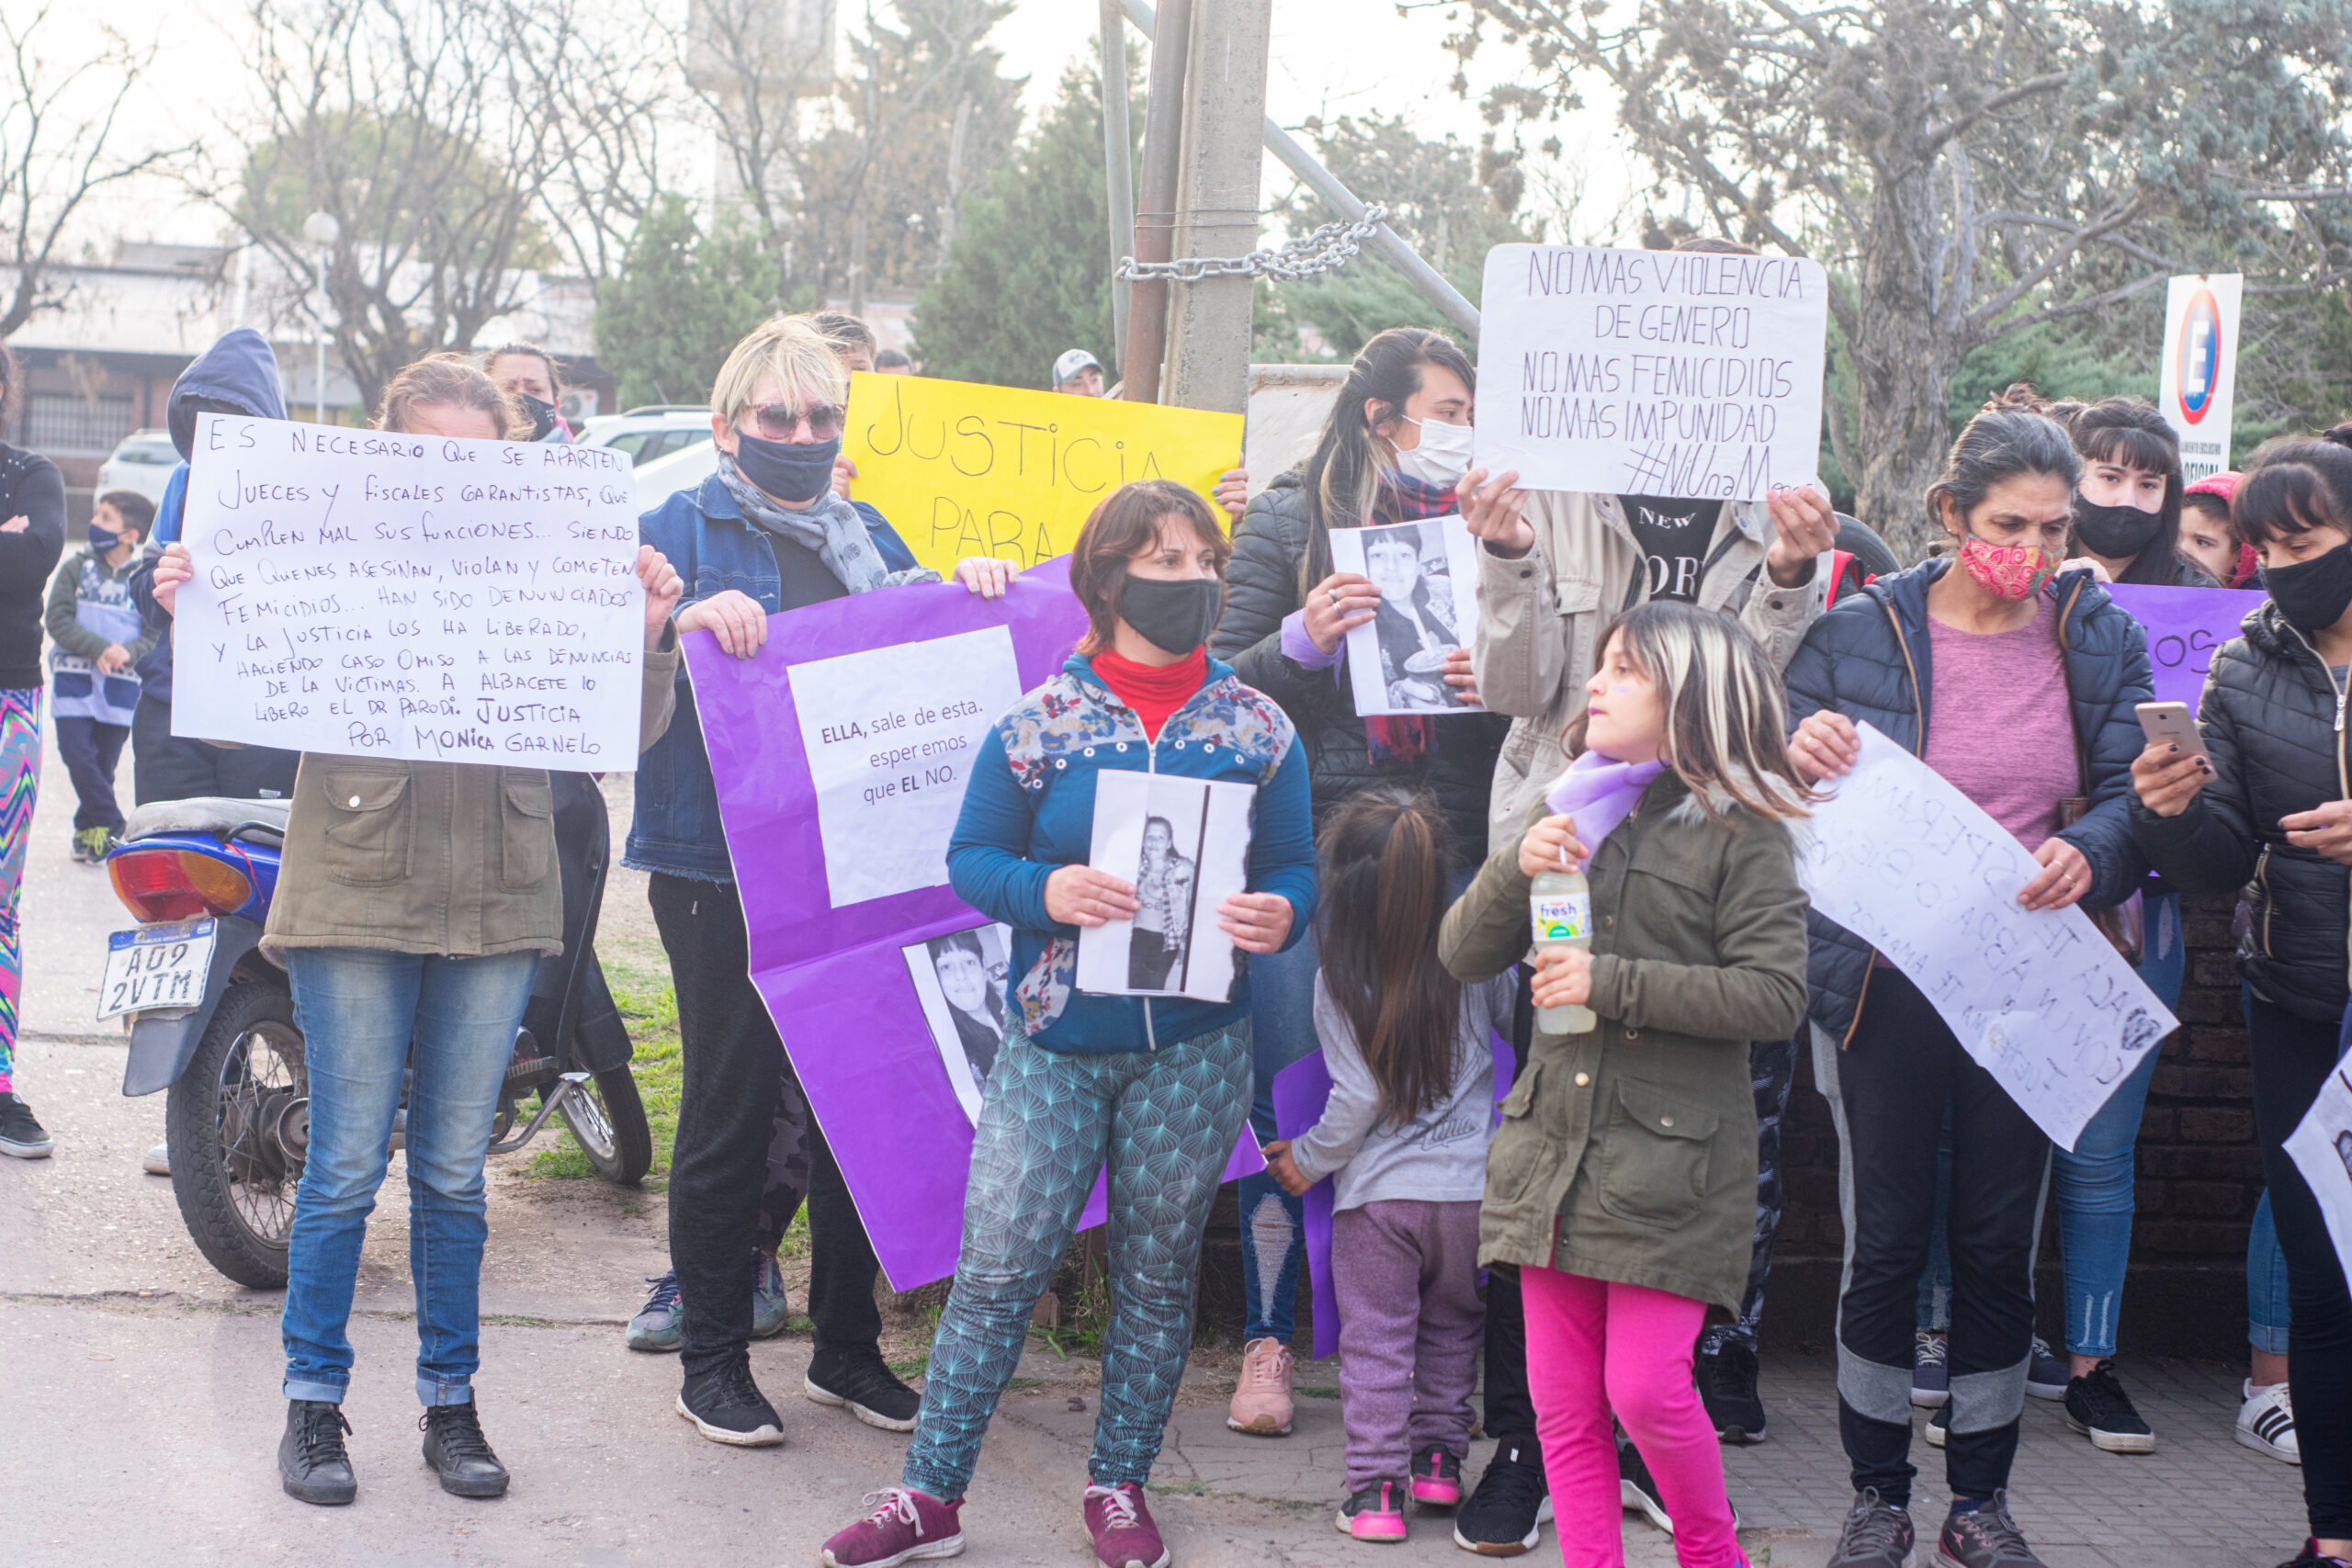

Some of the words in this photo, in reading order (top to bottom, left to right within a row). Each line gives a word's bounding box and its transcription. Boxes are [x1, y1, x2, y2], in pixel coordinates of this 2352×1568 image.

[1529, 251, 1573, 297] NO
[1581, 252, 1645, 295] MAS
[1653, 254, 1804, 299] VIOLENCIA
[1595, 304, 1632, 339] DE
[1639, 305, 1750, 348] GENERO
[1523, 351, 1557, 393] NO
[1565, 353, 1622, 394] MAS
[1632, 354, 1793, 398] FEMICIDIOS
[1521, 396, 1552, 438] NO
[1556, 397, 1617, 440] MAS
[1624, 400, 1776, 443] IMPUNIDAD
[210, 419, 255, 451] ES
[501, 446, 525, 467] SE
[544, 445, 623, 472] APARTEN
[218, 469, 310, 510] JUECES
[319, 525, 359, 545] MAL
[375, 522, 414, 540] SUS
[931, 495, 1053, 570] PARA
[1638, 506, 1697, 530] NEW
[552, 556, 636, 577] COMETEN
[377, 585, 417, 606] HAN
[245, 632, 268, 651] LA
[389, 618, 421, 637] LOS
[443, 618, 468, 636] HA
[341, 654, 386, 670] CASO
[478, 649, 490, 665] A
[504, 647, 532, 661] LAS
[265, 680, 289, 698] DE
[302, 675, 319, 693] LA
[442, 672, 456, 691] A
[481, 672, 569, 692] ALBACETE
[330, 698, 354, 716] EL
[368, 700, 388, 716] DR
[820, 721, 867, 745] ELLA,
[871, 711, 907, 735] sale
[914, 706, 936, 727] de
[942, 700, 984, 721] esta.
[347, 721, 391, 748] POR
[504, 732, 602, 756] GARNELO
[863, 782, 897, 807] que
[901, 775, 920, 794] EL
[925, 764, 957, 787] NO.
[1541, 903, 1577, 917] fresh
[126, 943, 188, 978] A09
[108, 969, 192, 1011] 2VTM
